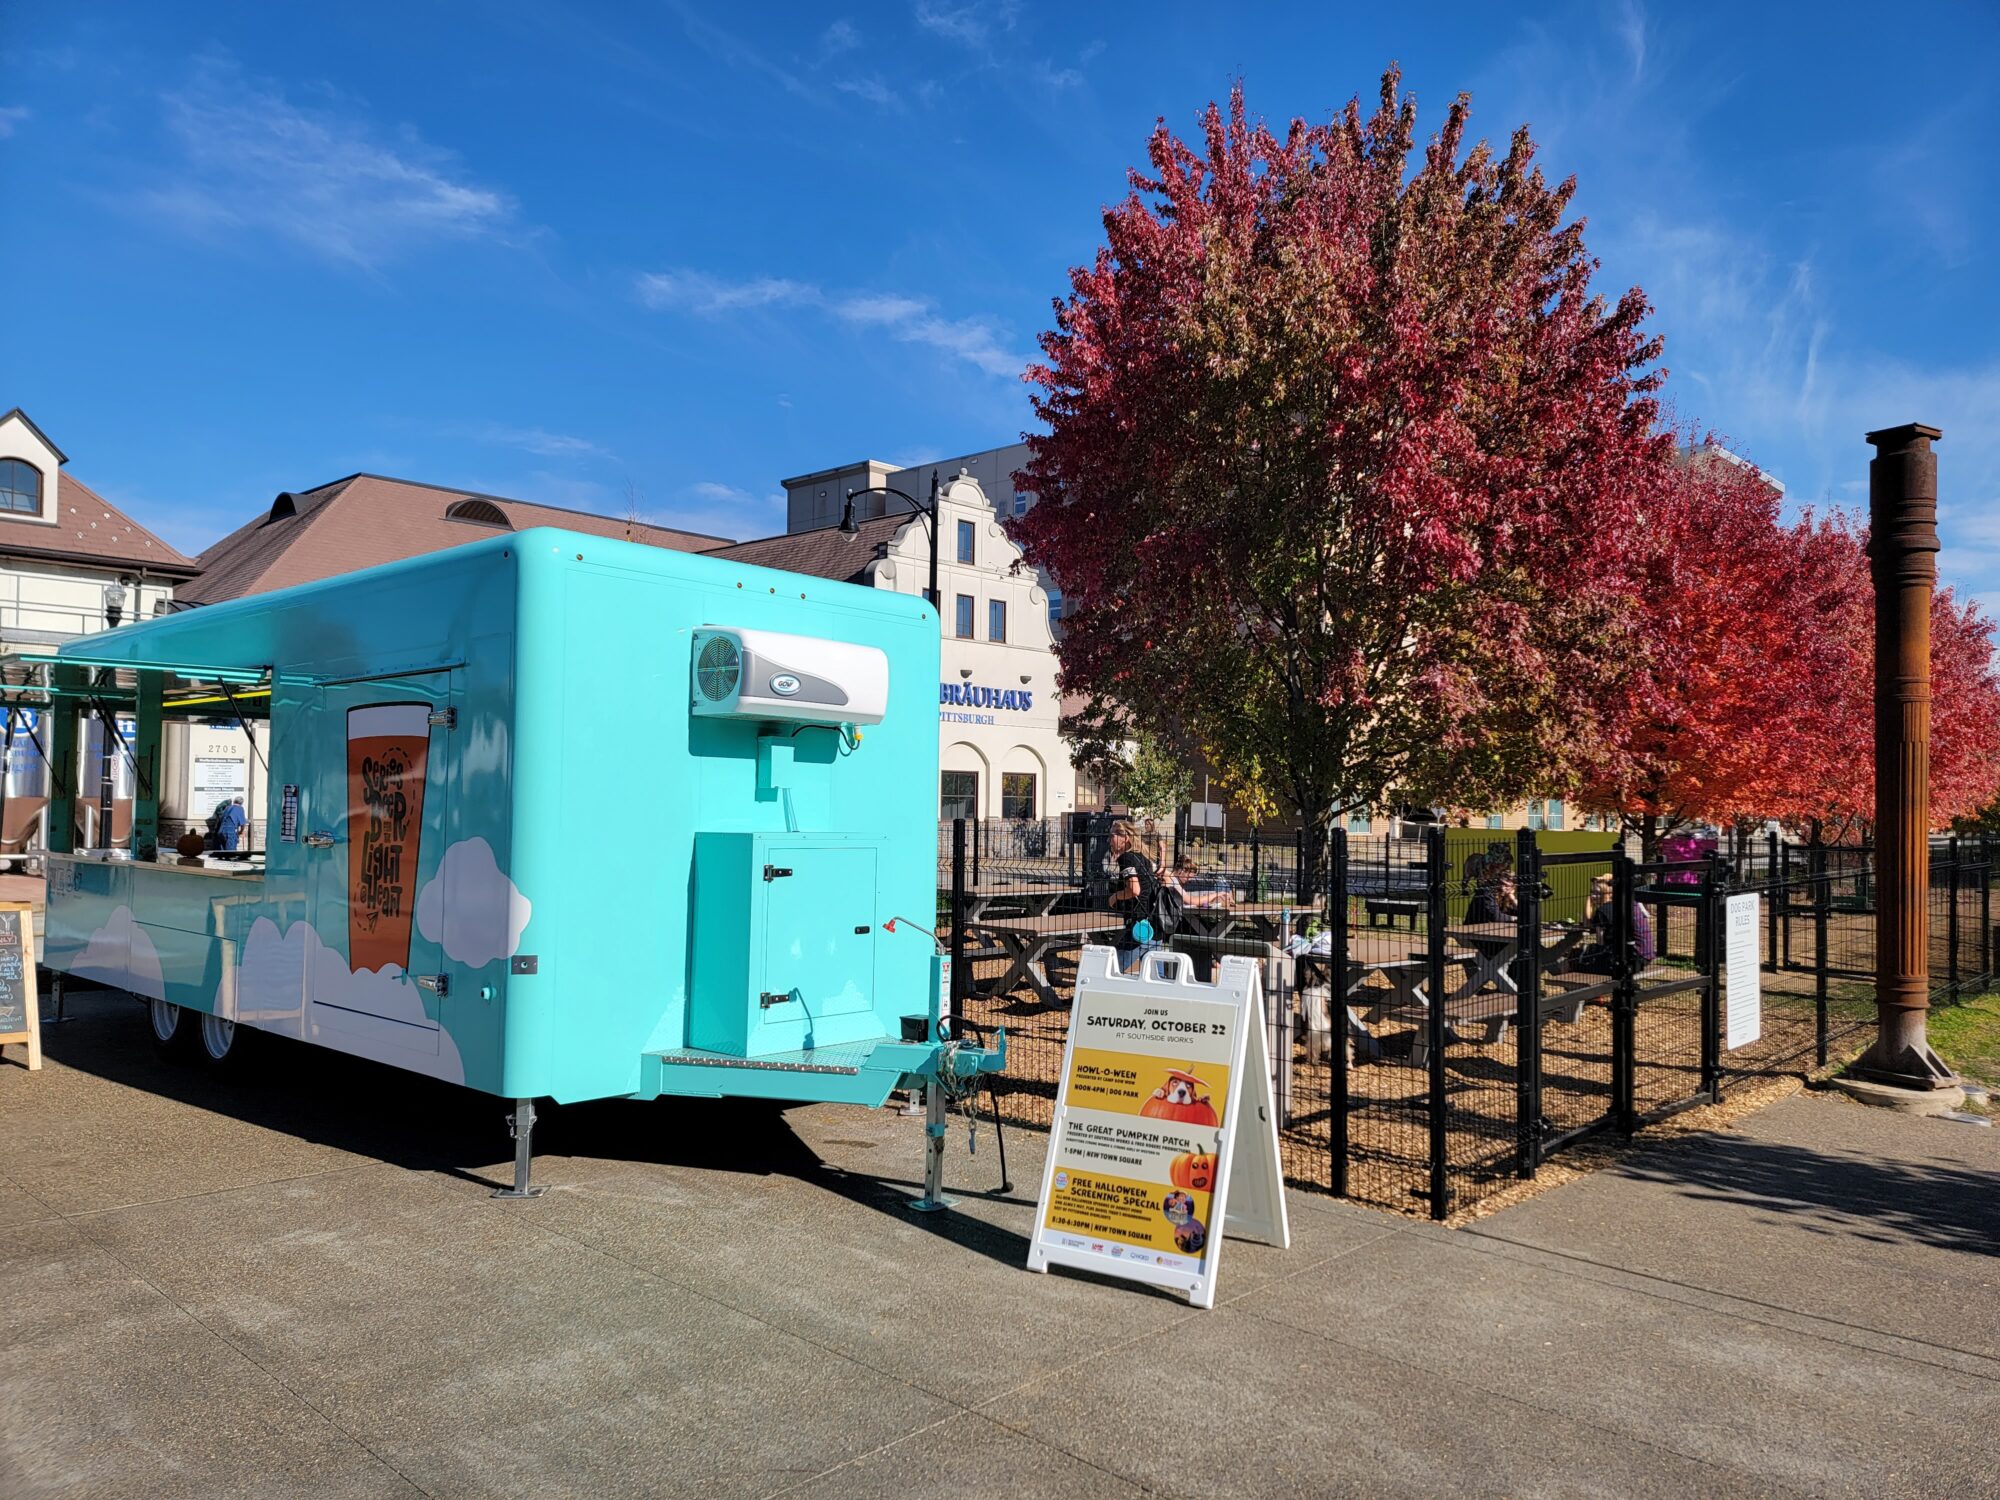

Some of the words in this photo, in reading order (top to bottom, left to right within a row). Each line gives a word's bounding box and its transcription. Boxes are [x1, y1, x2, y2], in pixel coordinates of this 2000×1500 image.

[208, 744, 237, 754] 2705
[1730, 902, 1741, 914] DOG
[1735, 914, 1750, 927] RULES
[1086, 1016, 1146, 1030] SATURDAY,
[1152, 1020, 1206, 1034] OCTOBER
[1212, 1024, 1226, 1035] 22
[1127, 1033, 1165, 1042] SOUTHSIDE
[1077, 1065, 1137, 1079] HOWL-O-WEEN
[1074, 1084, 1105, 1093] NOON-4PM
[1123, 1090, 1139, 1098] PARK
[1068, 1122, 1083, 1131] THE
[1086, 1124, 1114, 1135] GREAT
[1116, 1129, 1159, 1142] PUMPKIN
[1162, 1136, 1190, 1148] PATCH
[1119, 1156, 1142, 1166] SQUARE
[1072, 1178, 1092, 1188] FREE
[1095, 1182, 1147, 1198] HALLOWEEN
[1071, 1187, 1120, 1203] SCREENING
[1123, 1196, 1160, 1210] SPECIAL
[1109, 1227, 1126, 1236] TOWN
[1128, 1230, 1152, 1241] SQUARE
